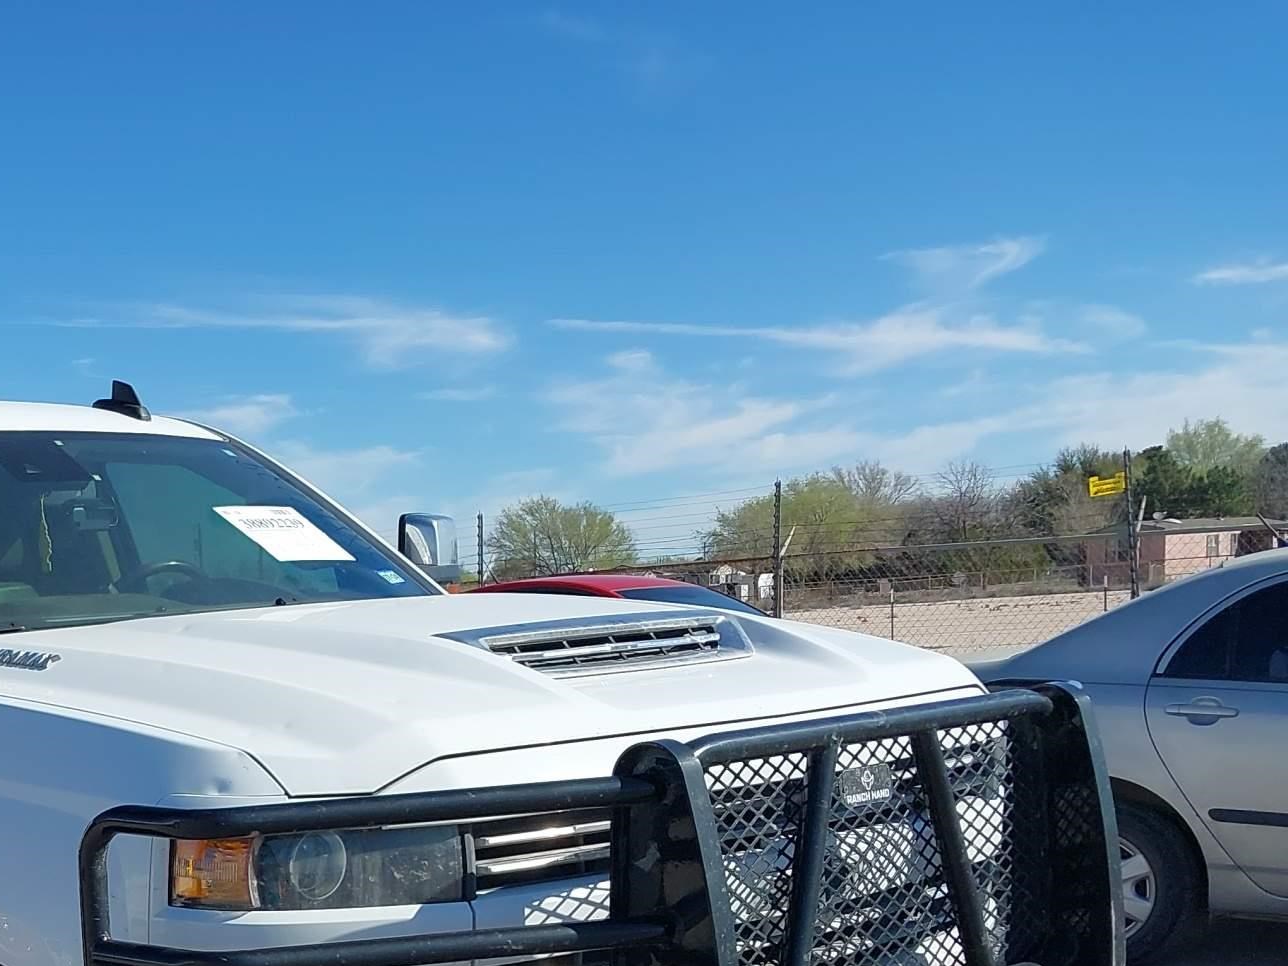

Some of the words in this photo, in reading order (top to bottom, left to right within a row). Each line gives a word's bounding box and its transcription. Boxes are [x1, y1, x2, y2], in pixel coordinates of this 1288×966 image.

[238, 518, 306, 530] 38892239
[846, 792, 871, 805] RANCH
[871, 788, 890, 800] HAND
